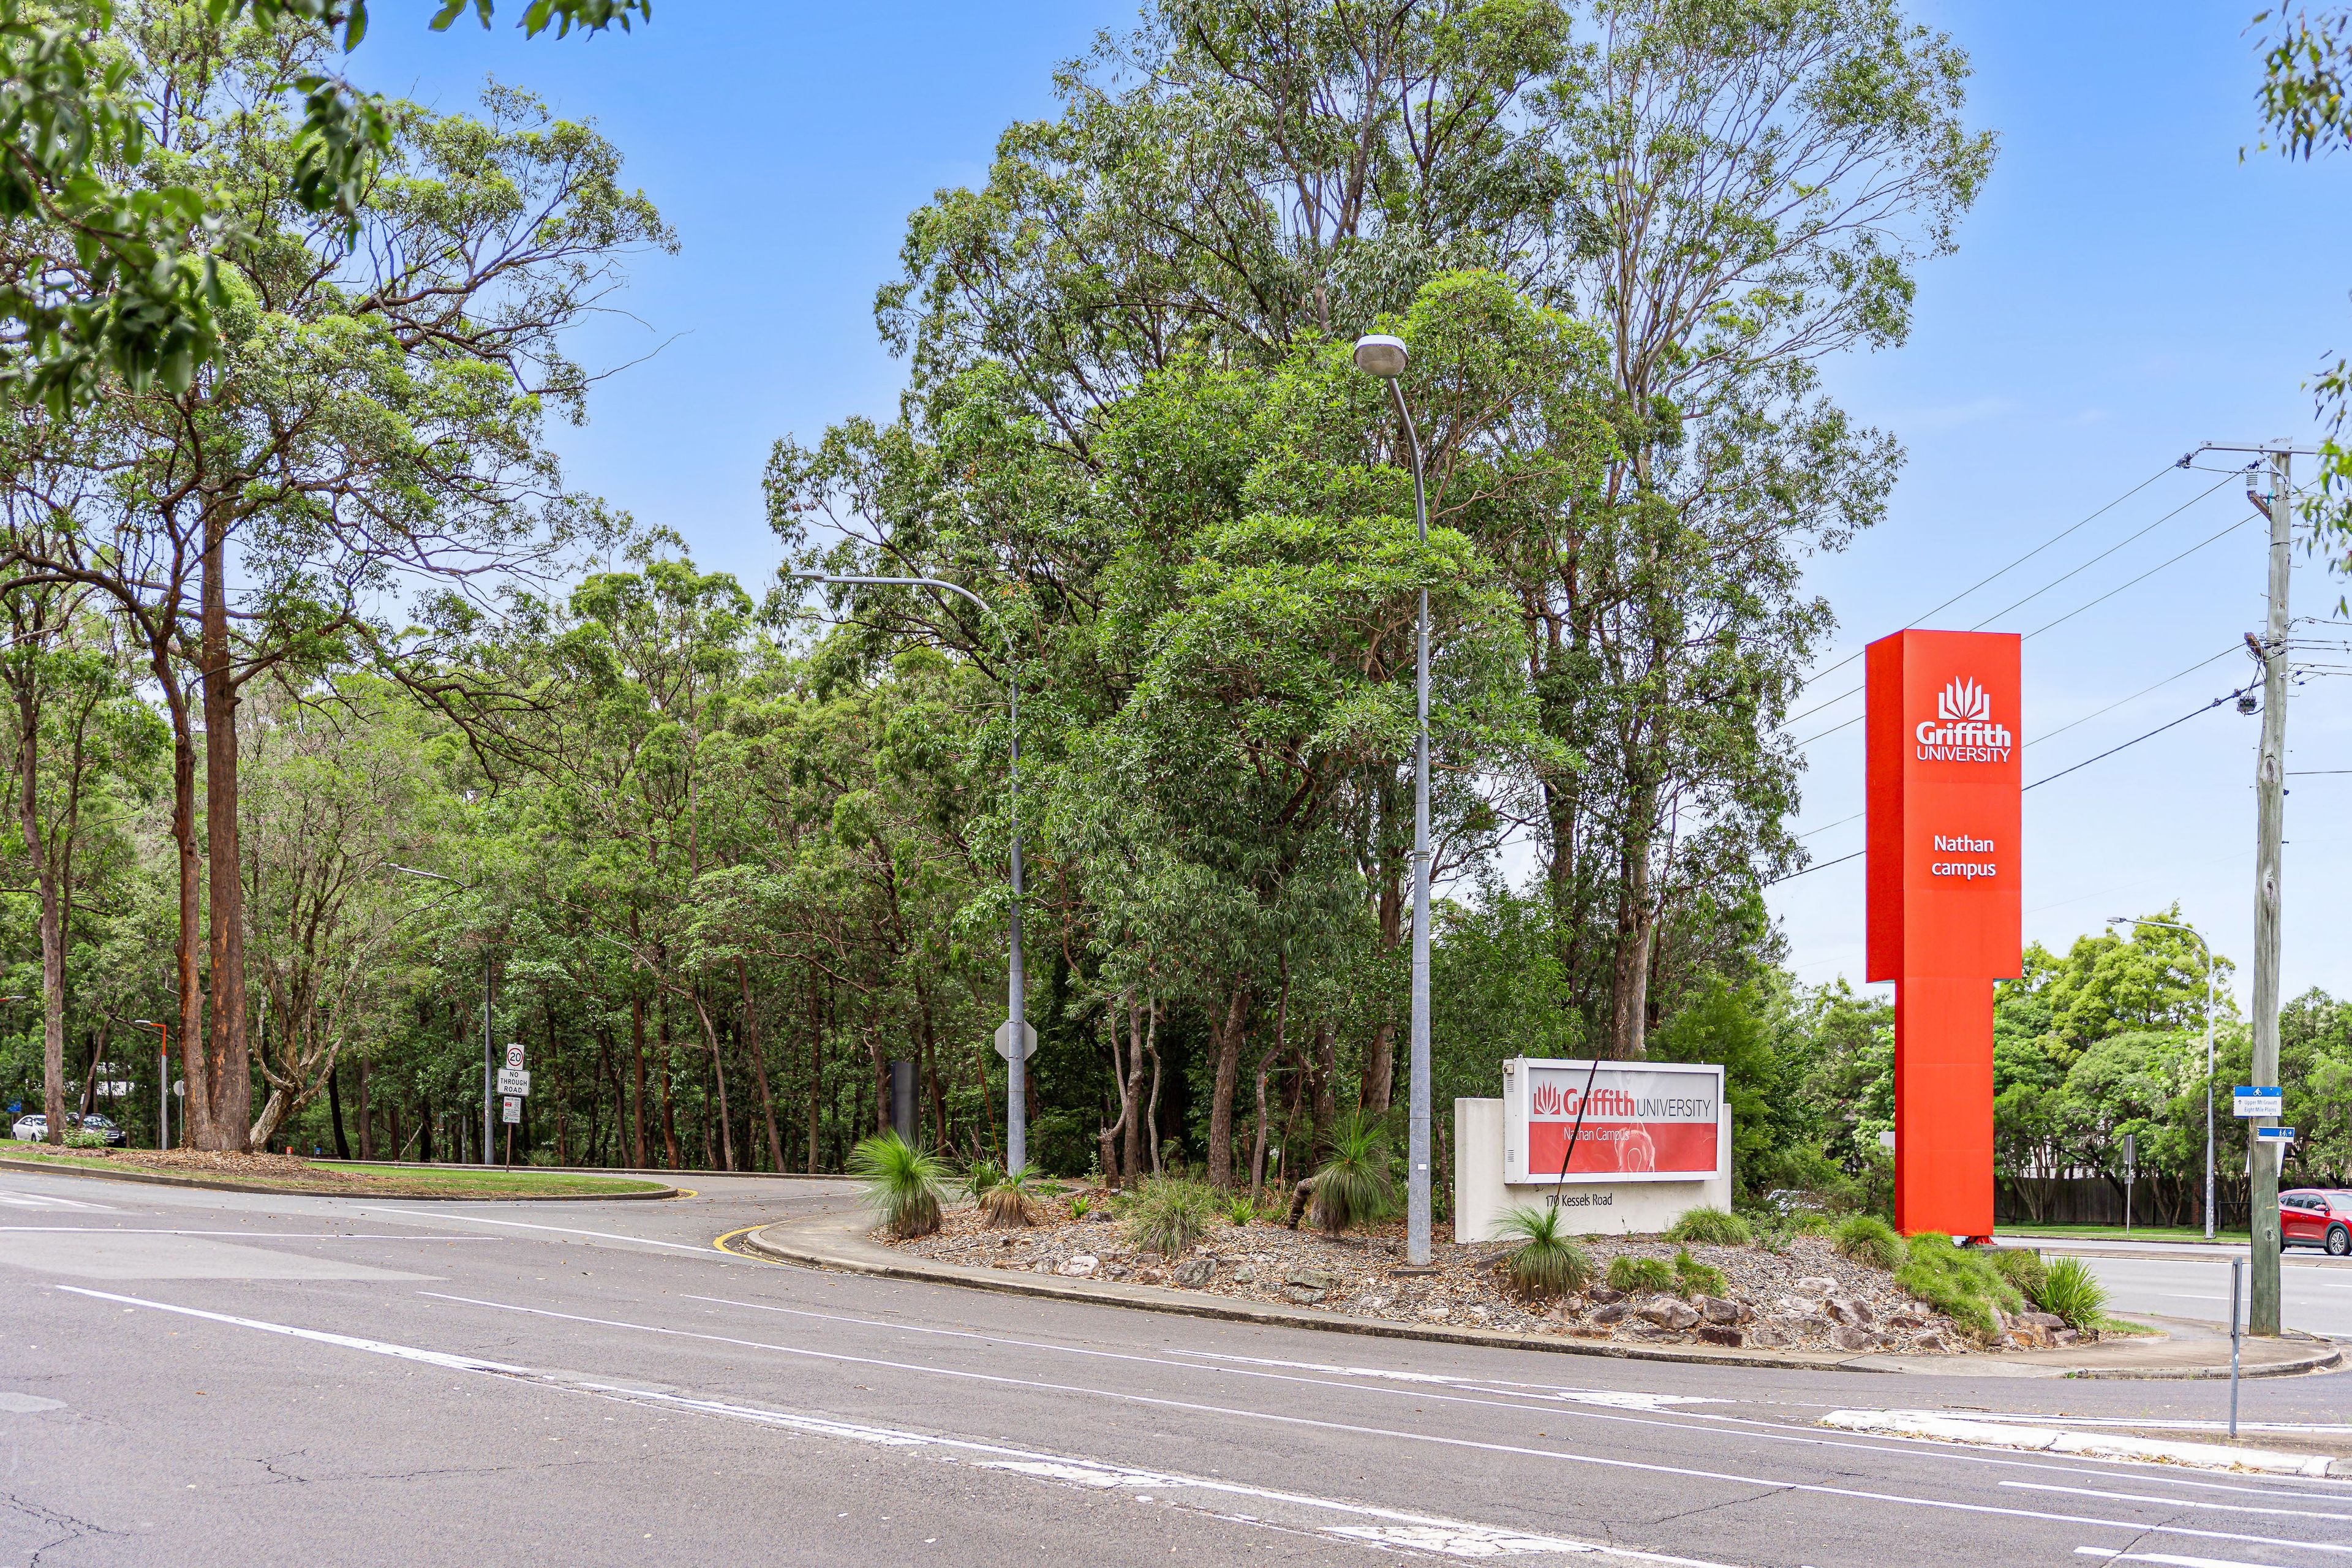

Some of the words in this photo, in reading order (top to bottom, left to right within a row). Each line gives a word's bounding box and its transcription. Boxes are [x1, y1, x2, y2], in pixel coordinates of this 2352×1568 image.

[1916, 721, 2011, 747] Griffith
[1917, 746, 2011, 762] UNIVERSITY
[1934, 835, 1994, 852] Nathan
[1932, 862, 1996, 880] campus
[510, 1052, 521, 1061] 20
[1563, 1088, 1635, 1116] Griffith
[1637, 1099, 1711, 1117] UNIVERSITY
[1596, 1127, 1629, 1142] Campus
[1545, 1195, 1559, 1207] 170
[1562, 1193, 1591, 1207] Kessels
[1593, 1193, 1613, 1206] Road
